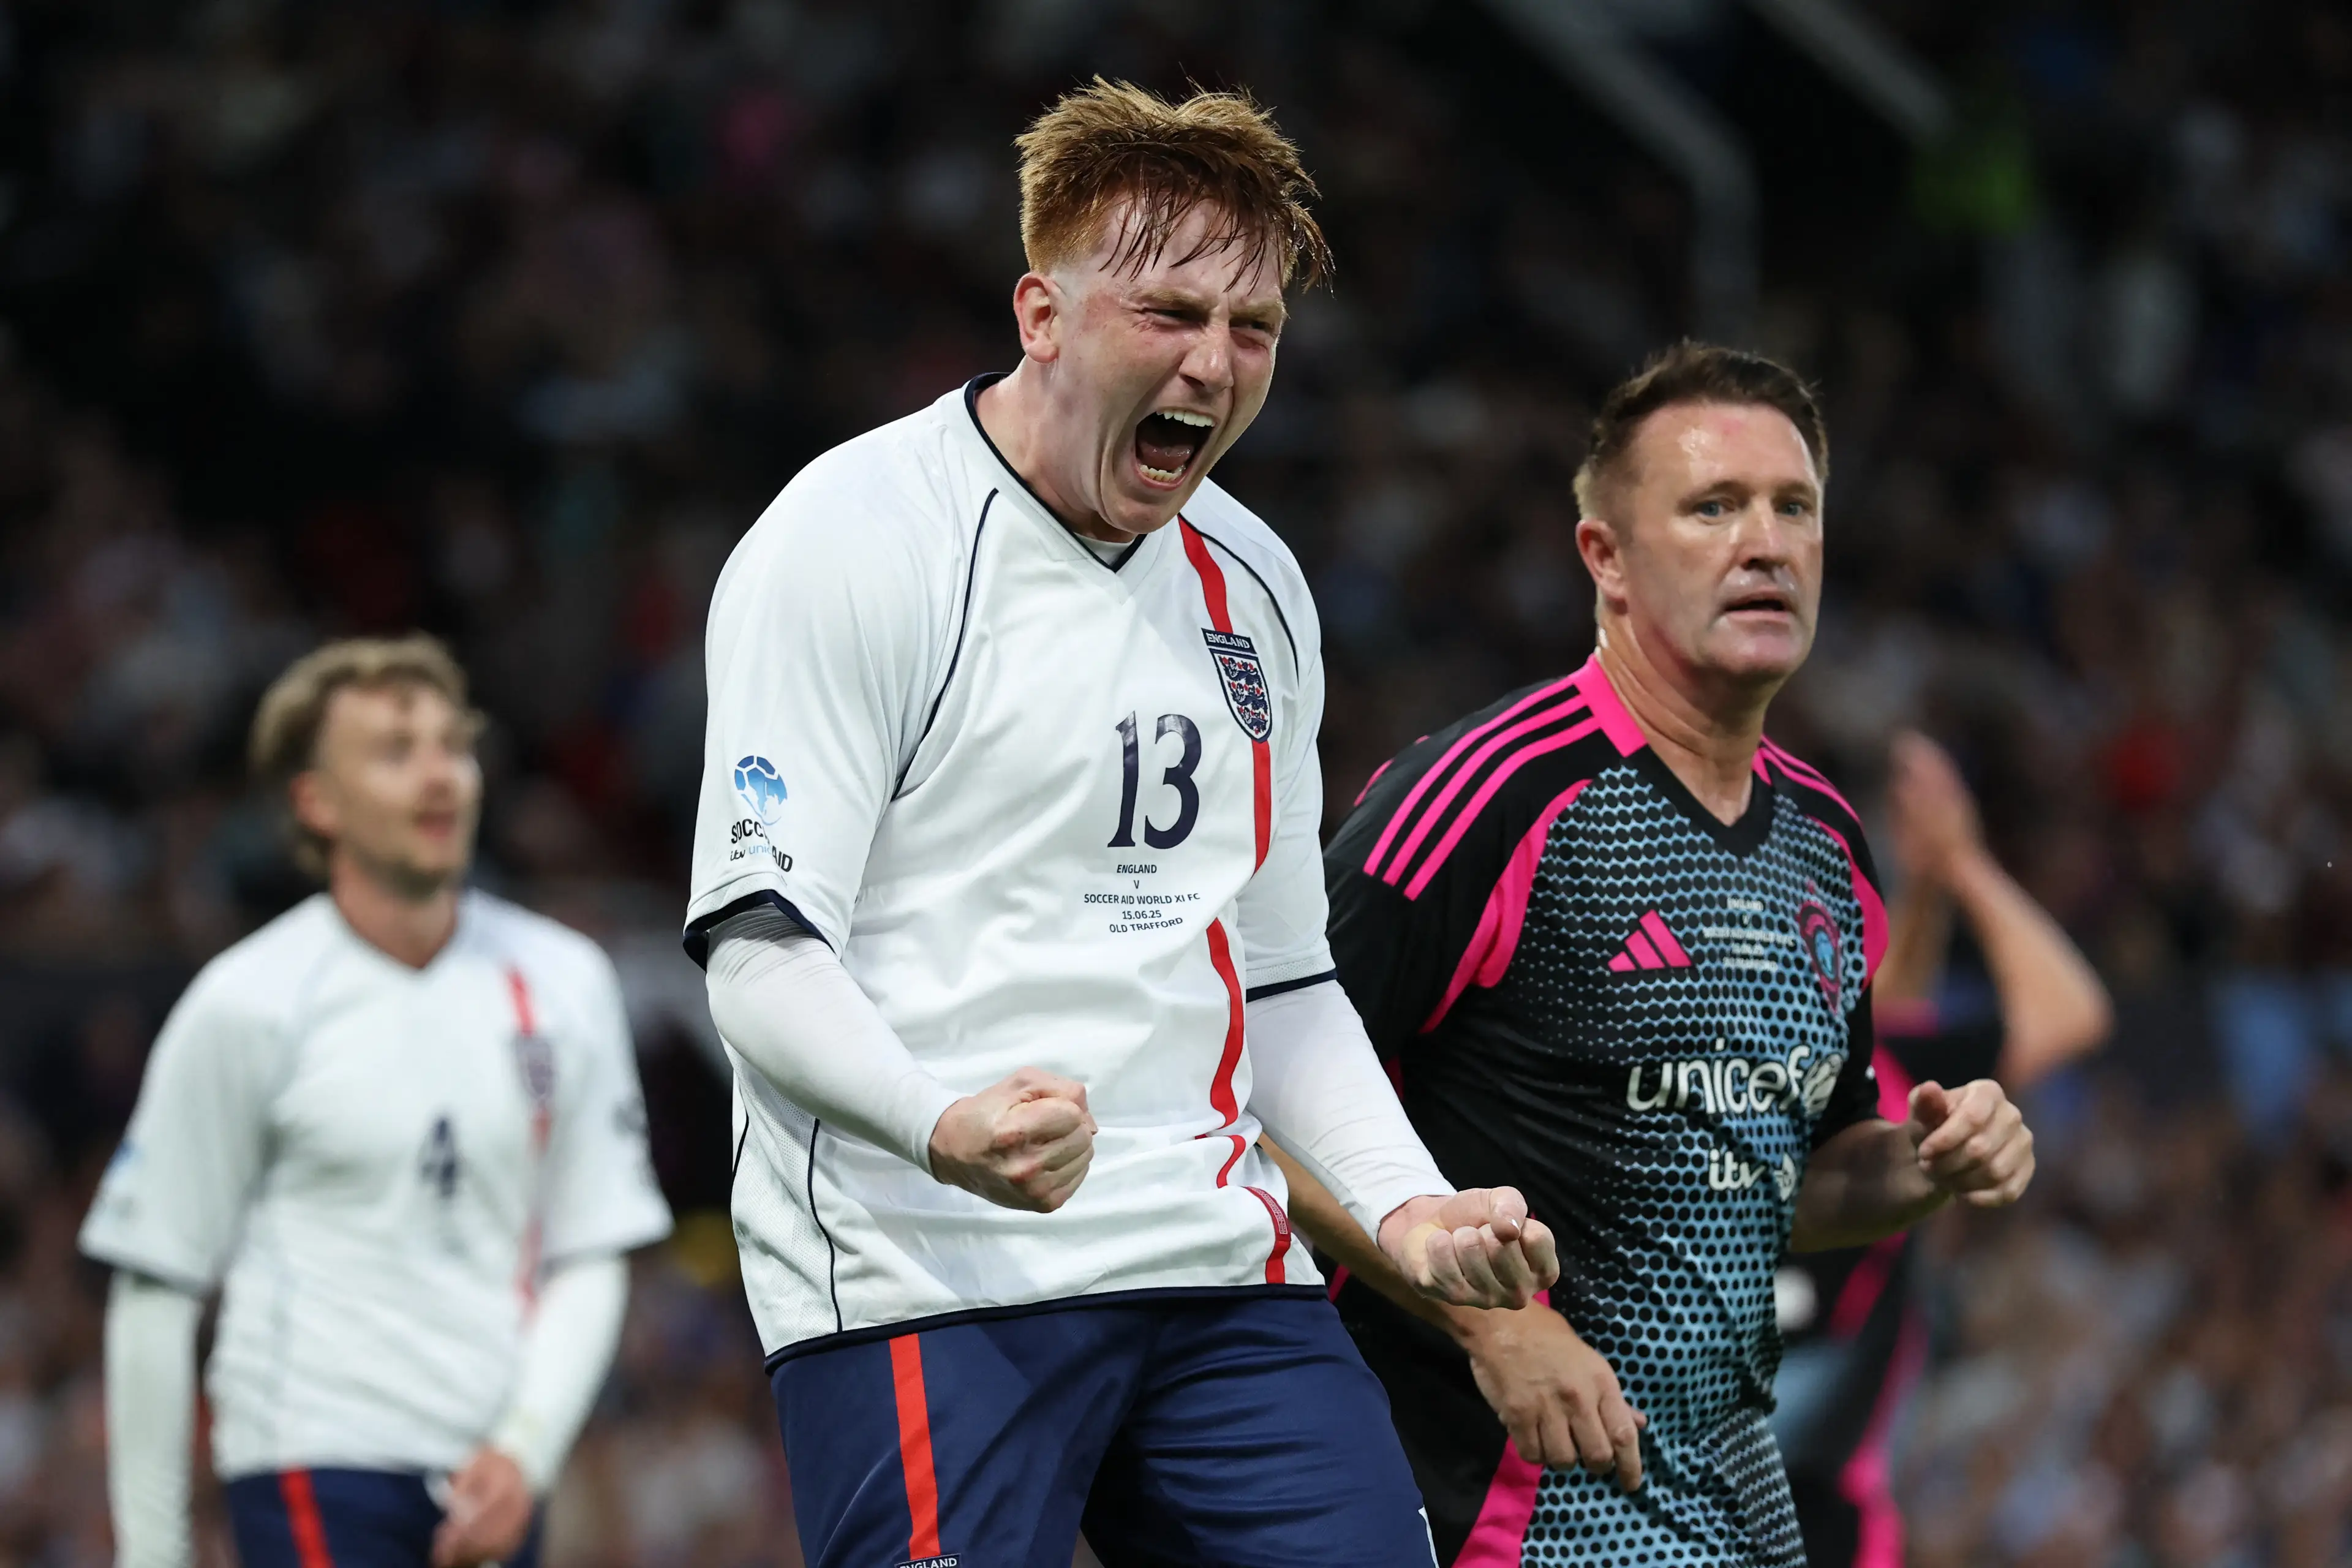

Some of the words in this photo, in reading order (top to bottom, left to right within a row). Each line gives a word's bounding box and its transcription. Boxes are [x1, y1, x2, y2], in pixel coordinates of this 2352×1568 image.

[1205, 633, 1250, 649] ENGLAND
[1107, 710, 1202, 850] 13
[731, 818, 770, 845] SOCC
[1117, 864, 1157, 873] ENGLAND
[1084, 894, 1120, 903] SOCCER
[1121, 895, 1134, 905] AID
[1137, 895, 1172, 905] WORLD
[1174, 894, 1185, 903] XI
[1187, 892, 1201, 901] FC
[1122, 910, 1162, 919] 15.06.25
[1109, 924, 1128, 933] OLD
[1129, 917, 1183, 932] TRAFFORD
[1626, 1038, 1811, 1114] unicef
[417, 1112, 459, 1202] 4
[1708, 1148, 1767, 1191] itv
[900, 1557, 957, 1568] GLAND
